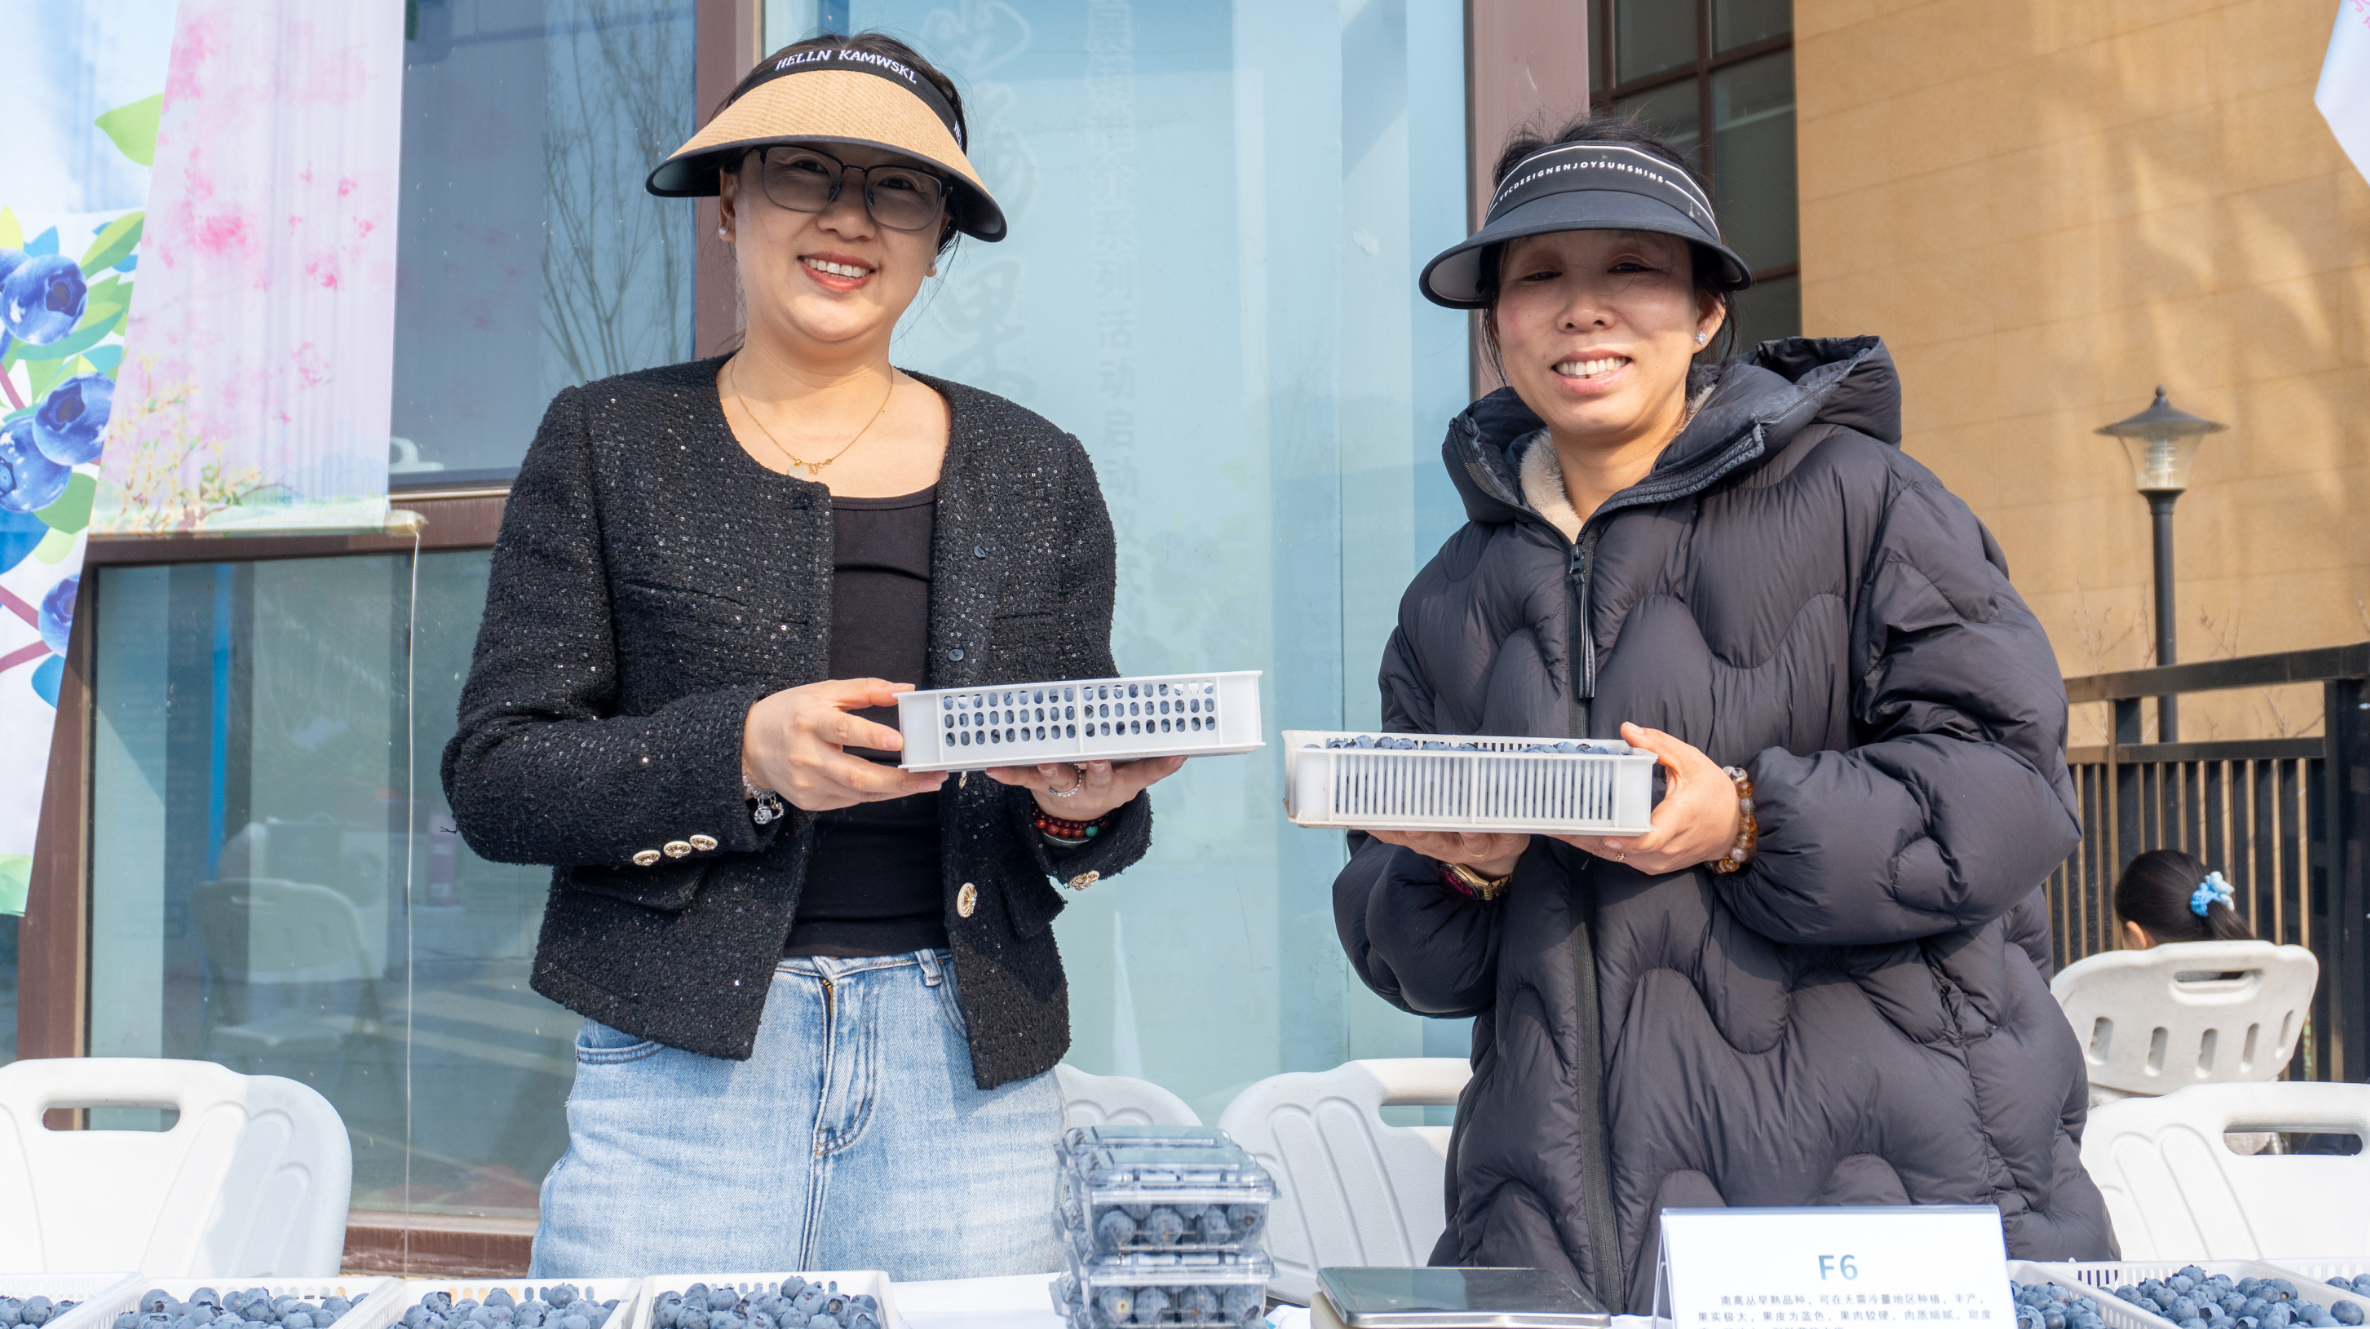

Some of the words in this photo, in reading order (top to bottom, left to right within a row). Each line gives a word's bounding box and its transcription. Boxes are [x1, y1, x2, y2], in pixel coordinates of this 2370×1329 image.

[775, 50, 833, 71] HELLN
[838, 50, 917, 84] KAMWSKL
[1818, 1254, 1859, 1281] F6
